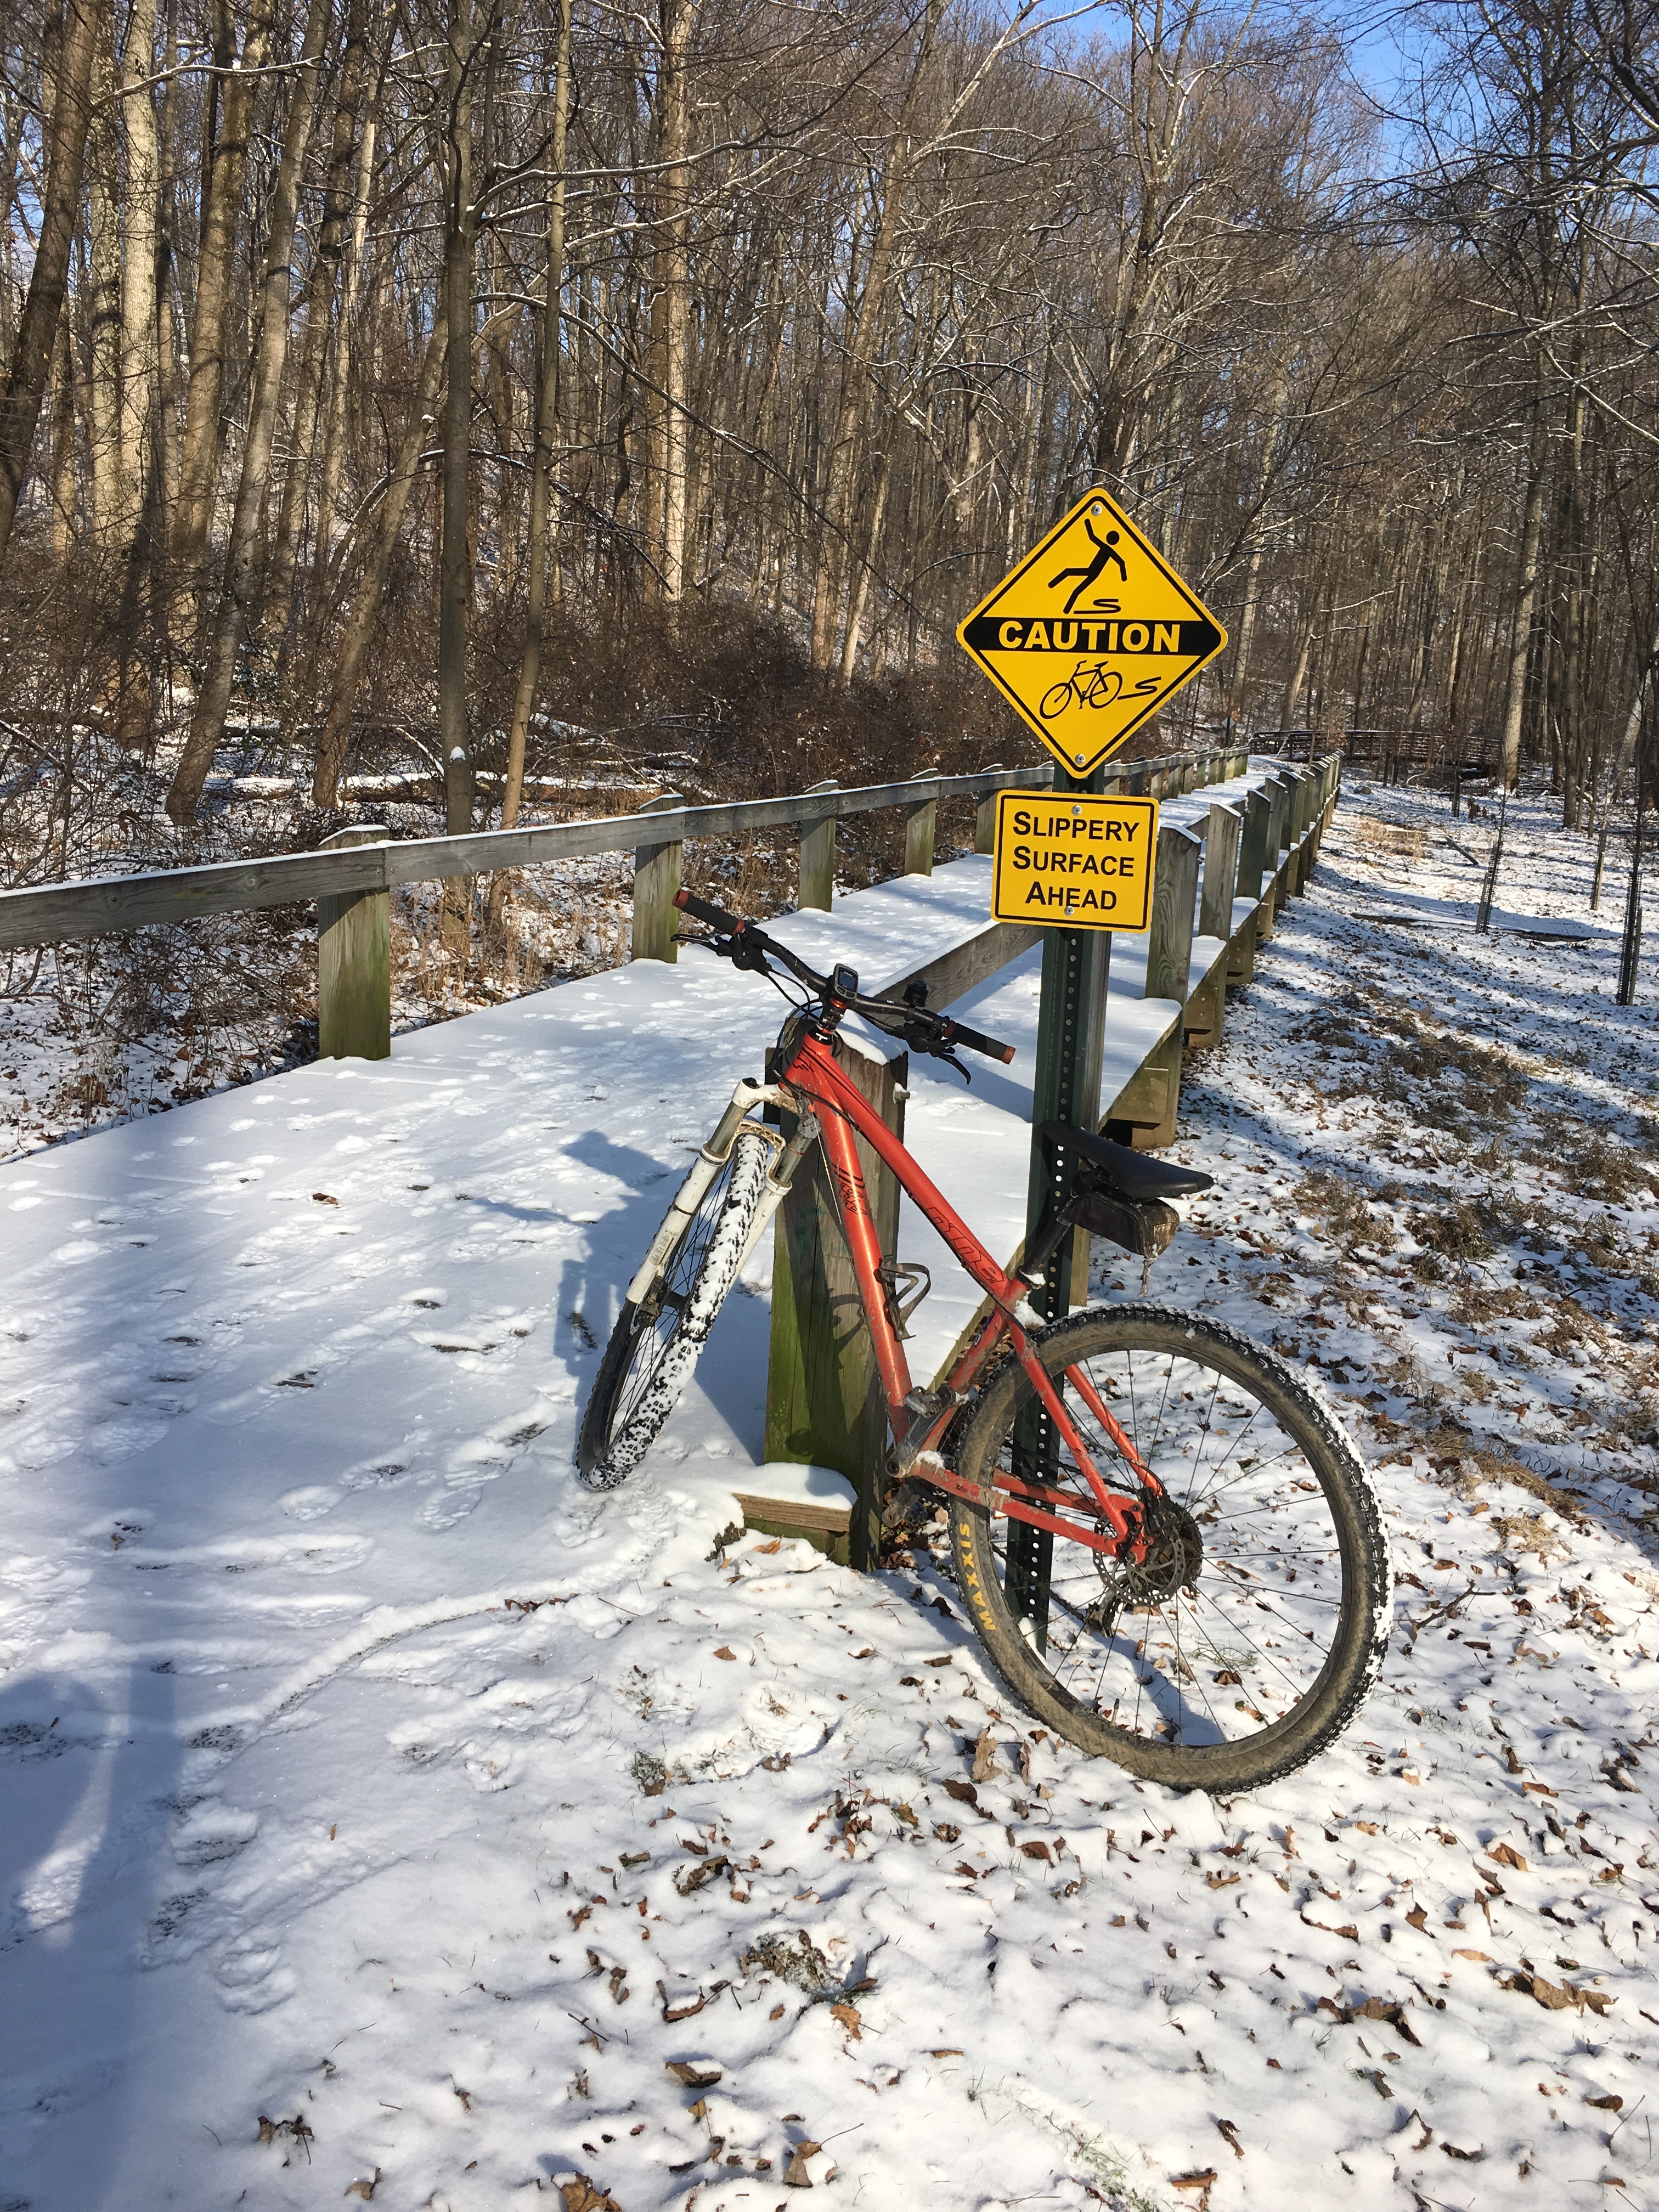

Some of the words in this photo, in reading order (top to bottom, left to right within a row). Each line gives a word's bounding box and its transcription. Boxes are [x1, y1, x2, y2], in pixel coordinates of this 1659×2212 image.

[999, 620, 1180, 652] CAUTION
[1013, 811, 1140, 842] SLIPPERY
[1012, 845, 1135, 877] SURFACE
[1025, 881, 1117, 910] AHEAD
[960, 1523, 997, 1630] MAXXIS
